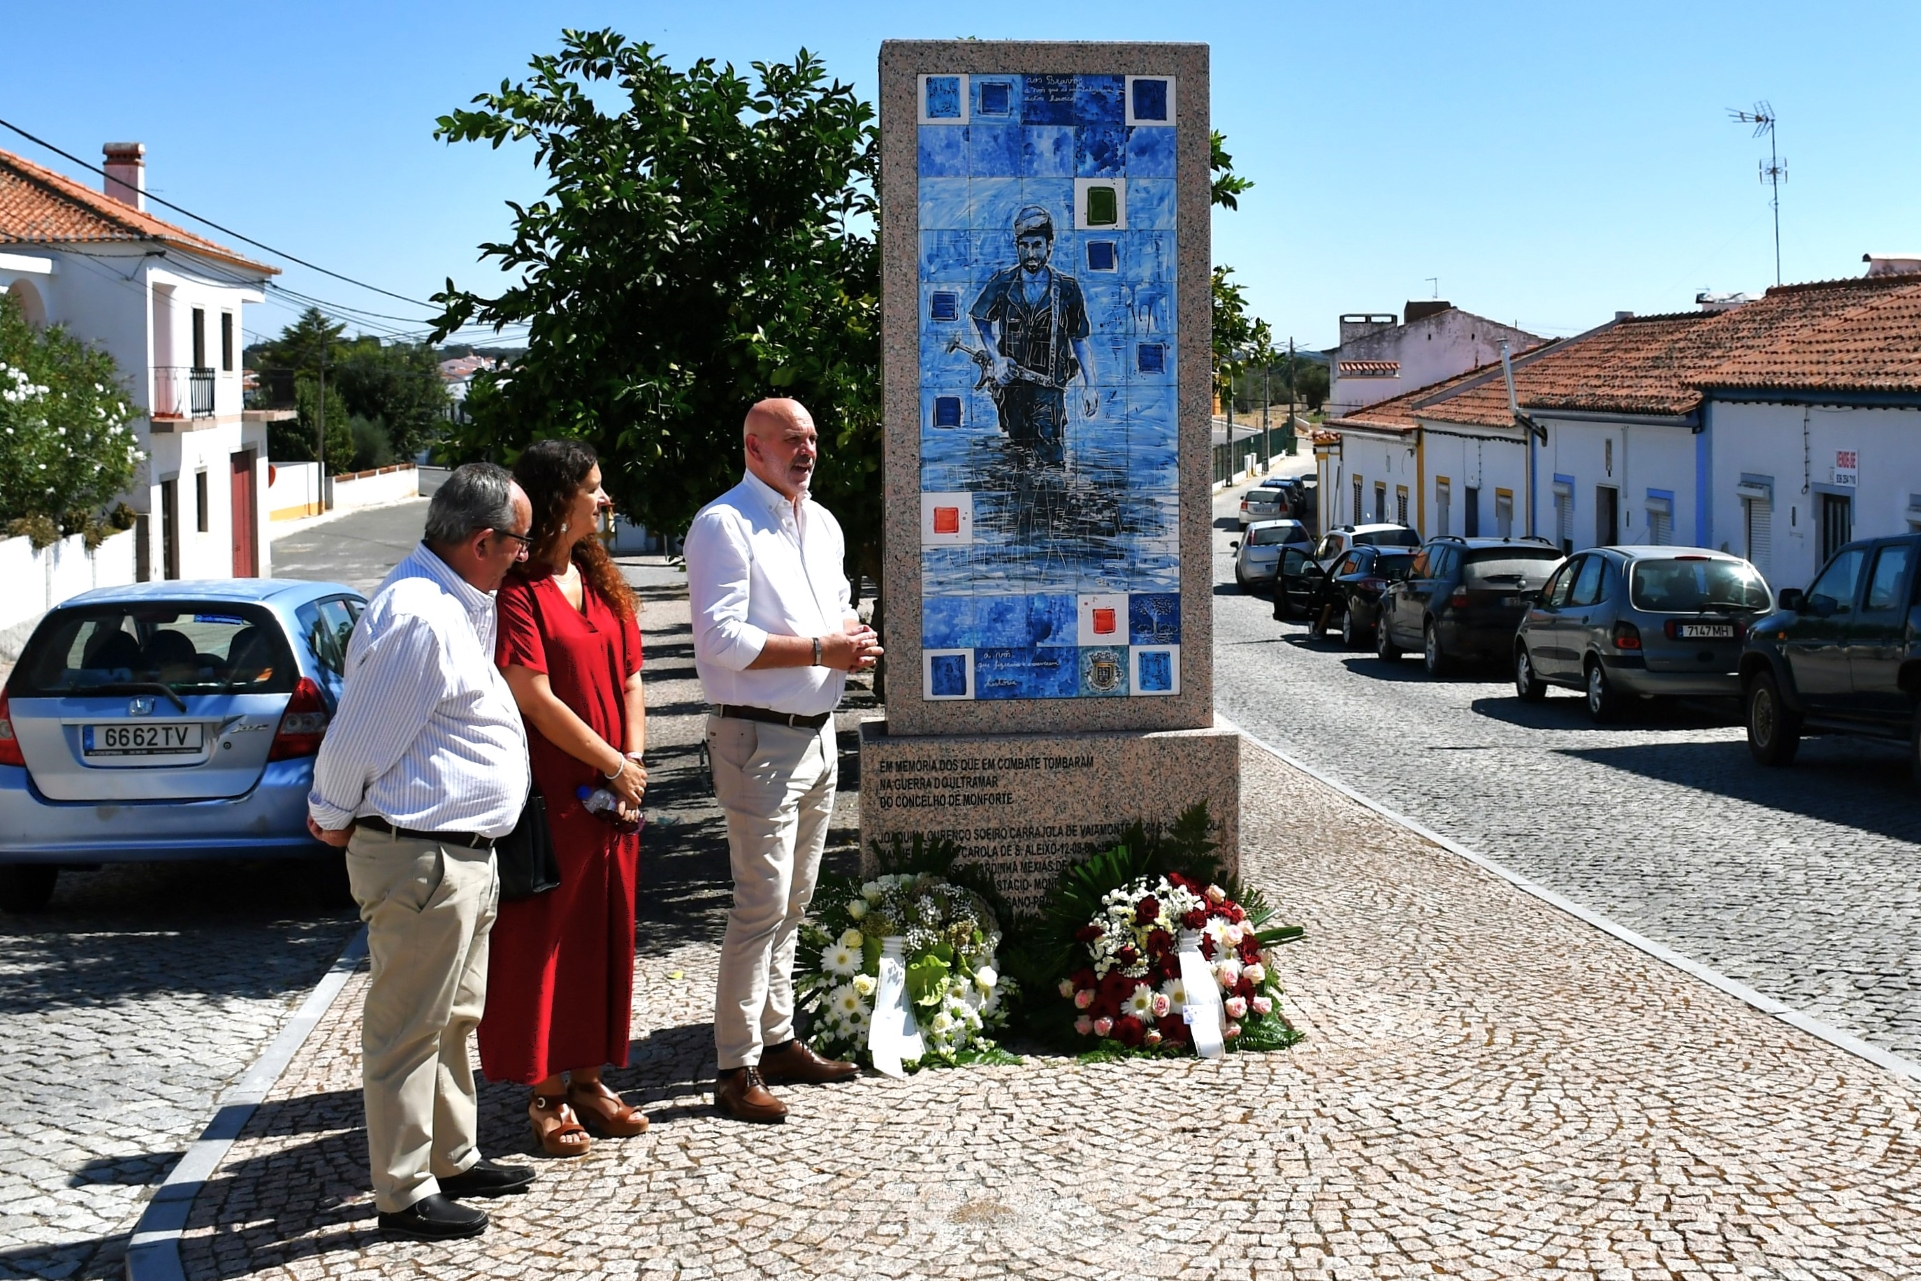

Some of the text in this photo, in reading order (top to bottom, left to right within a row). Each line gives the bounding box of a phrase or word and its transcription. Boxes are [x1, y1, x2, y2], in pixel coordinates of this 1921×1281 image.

[879, 760, 893, 772] EM
[939, 759, 958, 772] DOS
[960, 758, 980, 771] QUE
[982, 758, 995, 771] EM
[997, 757, 1041, 770] COMBATE
[1043, 756, 1094, 770] TOMBARAM
[879, 779, 893, 790] NA
[894, 777, 932, 790] GUERRA
[879, 793, 1013, 808] DO CONCELHO DE MONFORTE
[973, 827, 1007, 840] SOEIRO
[1009, 826, 1063, 839] CARRAJOLA
[1065, 825, 1078, 837] DE
[961, 846, 998, 858] CAROLA
[1000, 845, 1013, 857] DE
